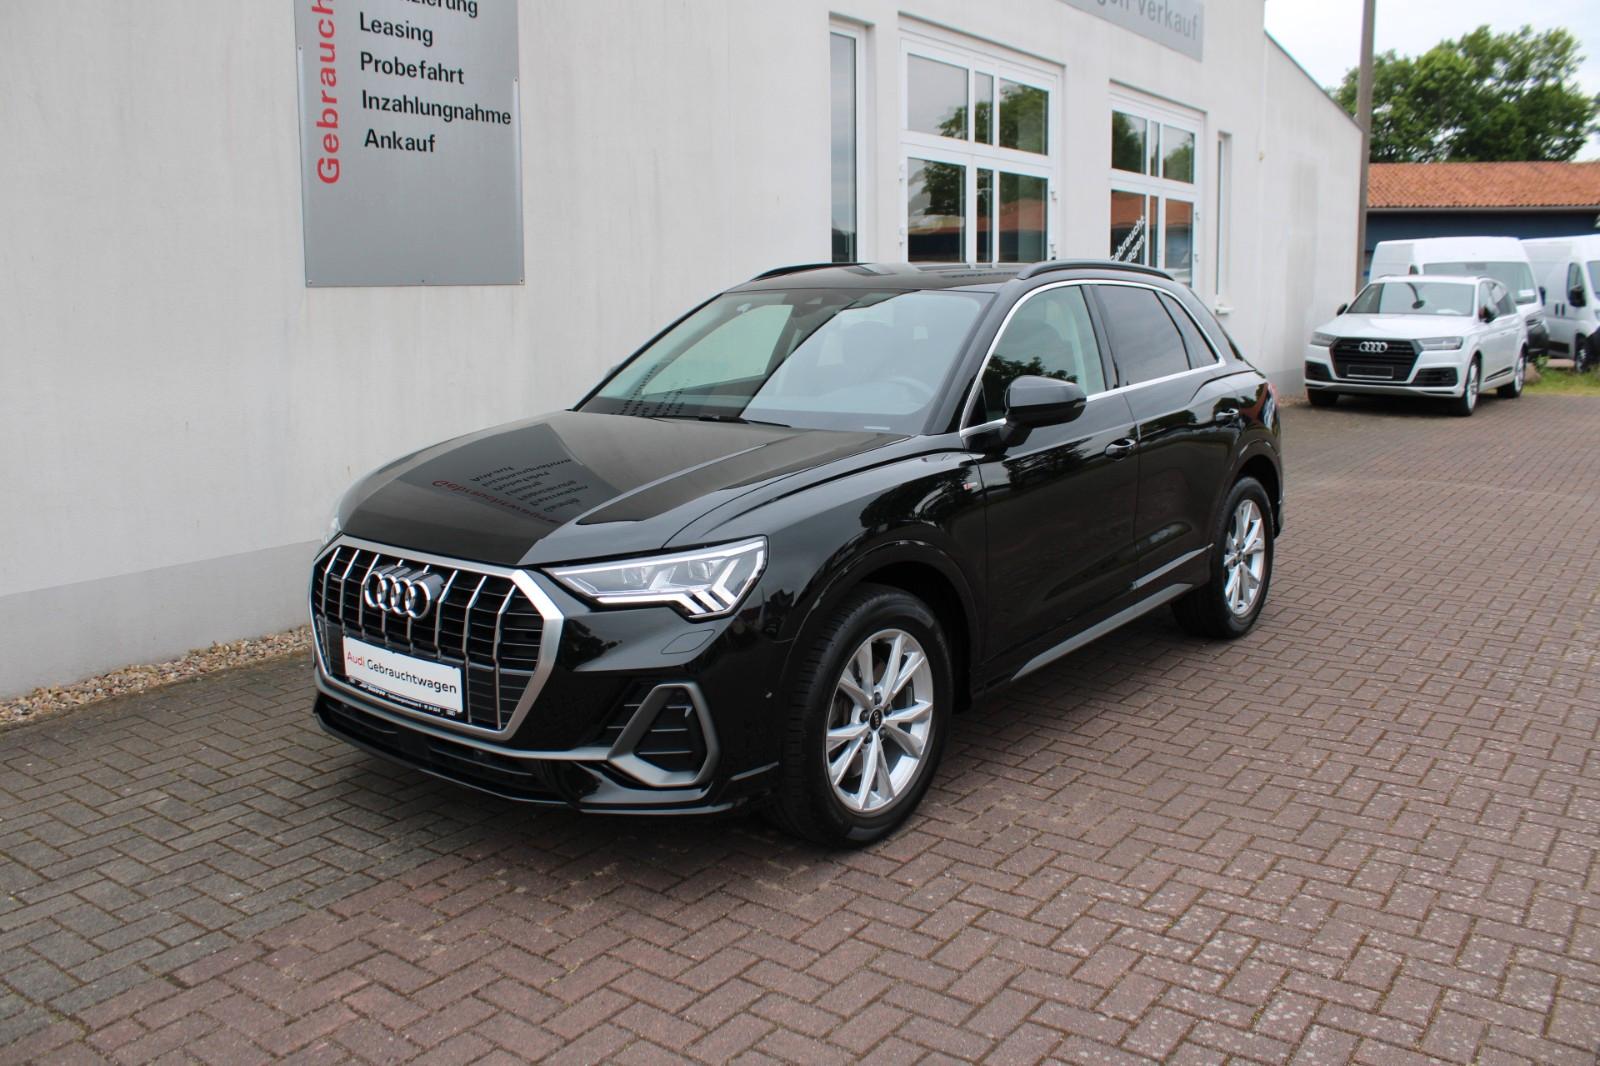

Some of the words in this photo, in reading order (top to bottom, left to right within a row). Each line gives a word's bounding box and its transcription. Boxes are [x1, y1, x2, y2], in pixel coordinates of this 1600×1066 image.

[359, 11, 434, 47] Leasing
[360, 51, 464, 85] Probefahrt
[361, 89, 512, 125] Inzahlungnahme
[364, 128, 436, 153] Ankauf
[347, 650, 365, 667] Audi
[367, 658, 457, 694] Gebrauchtwagen
